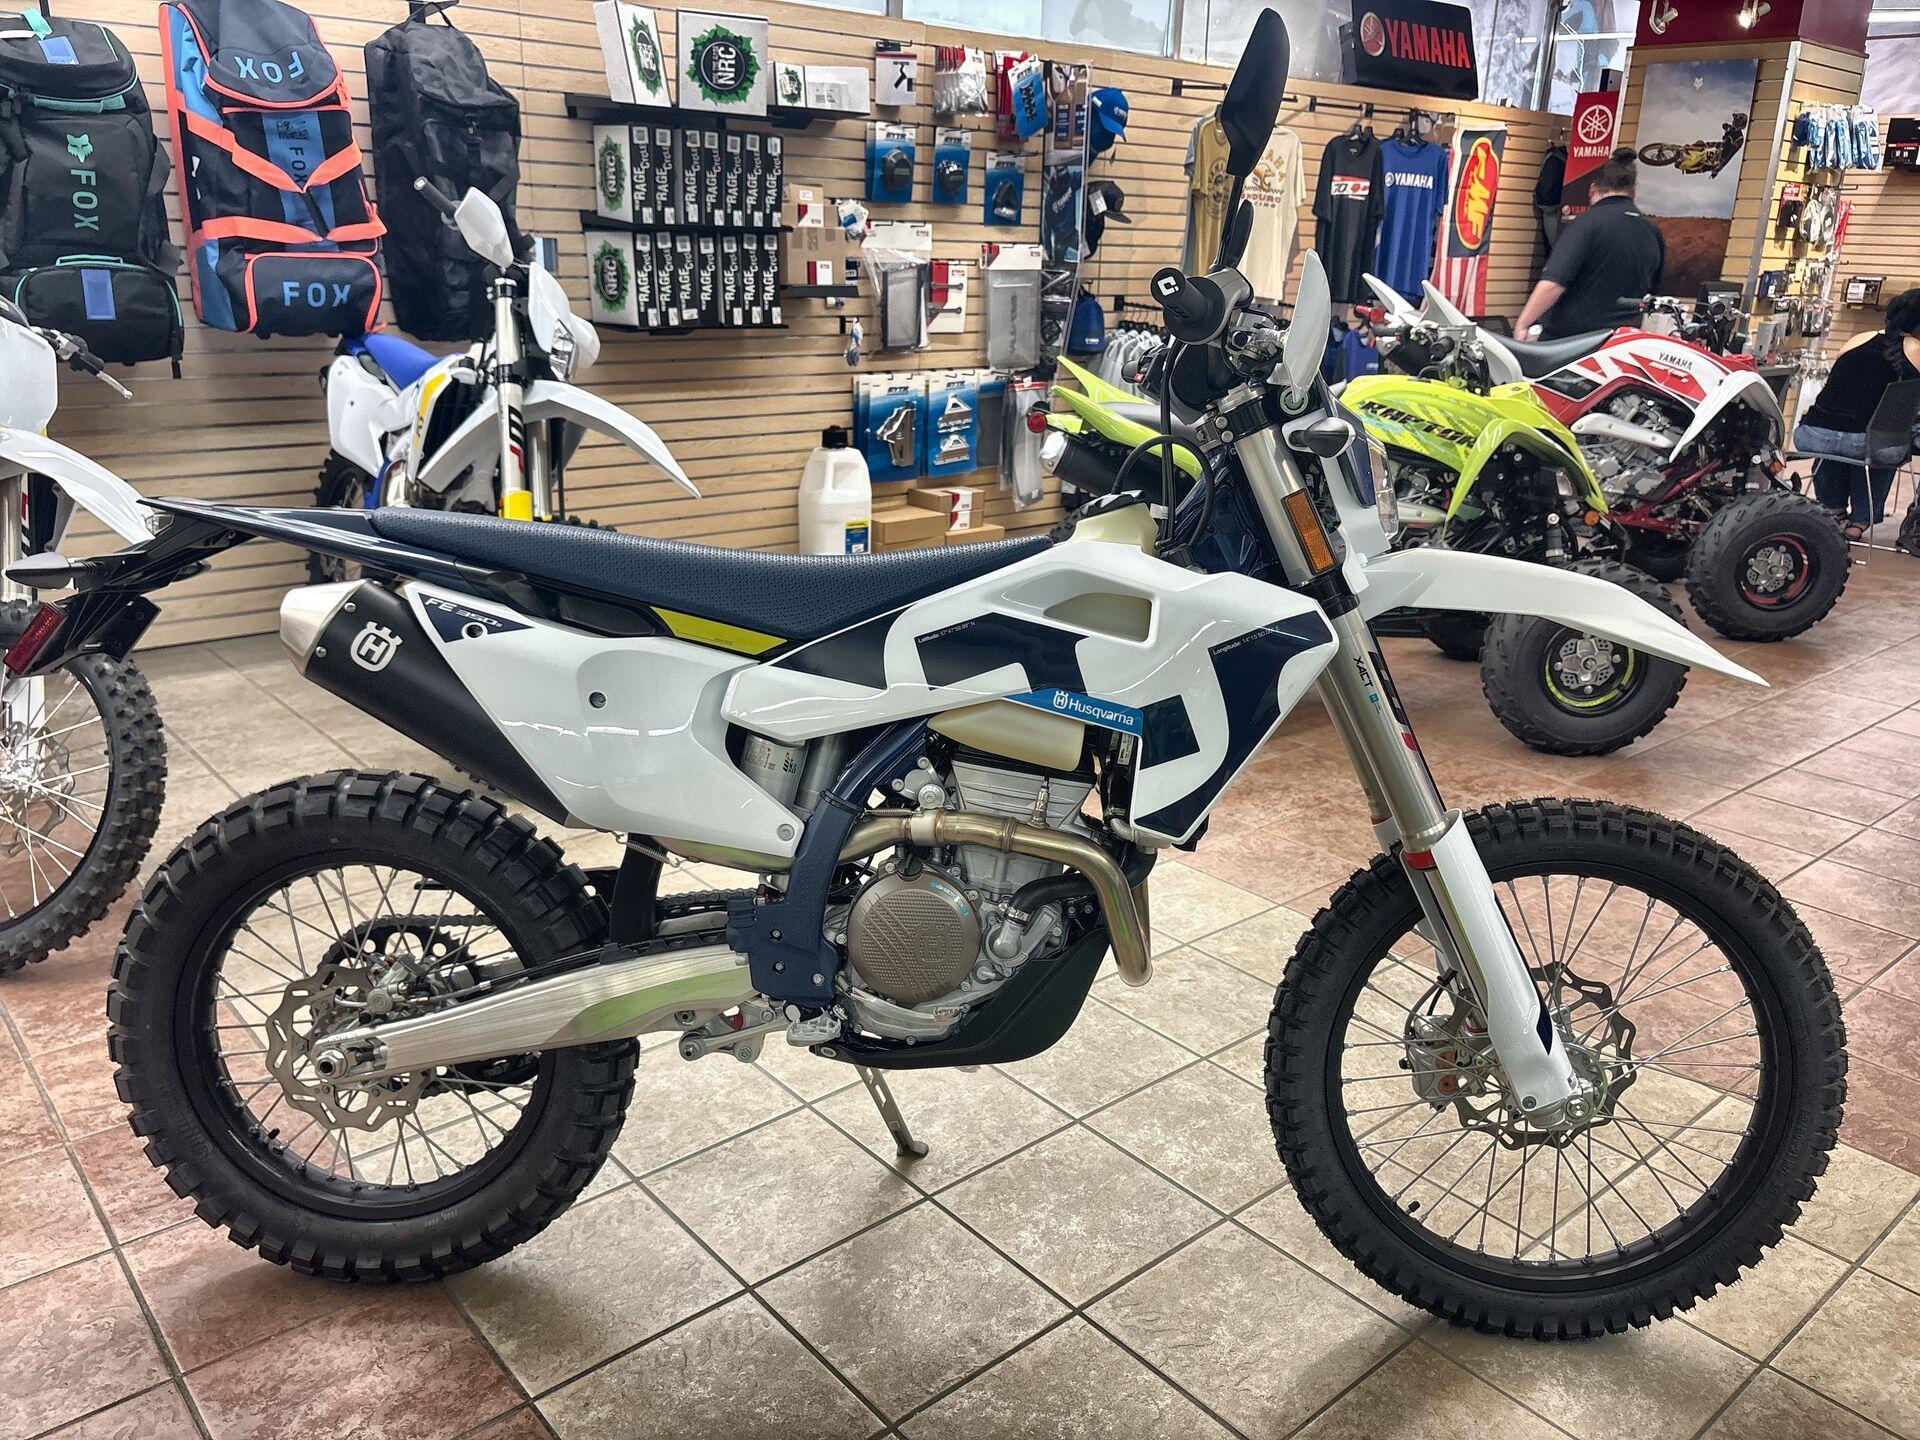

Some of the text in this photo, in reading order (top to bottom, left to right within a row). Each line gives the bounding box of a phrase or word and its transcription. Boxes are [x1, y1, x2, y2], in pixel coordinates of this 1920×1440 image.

[1385, 18, 1470, 68] YAMAHA
[234, 51, 305, 83] FOX
[717, 47, 737, 85] NRC
[289, 147, 309, 183] FOX
[1573, 146, 1610, 157] YAMAHA
[634, 167, 647, 200] RAGE
[656, 168, 669, 200] RAGE
[685, 170, 697, 202] RAGE
[706, 170, 717, 203] RAGE
[726, 172, 738, 204] RAGE
[746, 173, 758, 204] RAGE
[765, 173, 777, 204] RAGE
[1395, 172, 1433, 190] YAMAHA
[70, 168, 99, 231] FOX
[282, 281, 351, 307] FOX
[638, 270, 650, 302] RAGE
[659, 270, 671, 301] RAGE
[678, 268, 691, 299] RAGE
[700, 269, 712, 300] RAGE
[724, 270, 735, 300] RAGE
[744, 270, 755, 300] RAGE
[763, 271, 775, 300] RAGE
[1659, 352, 1692, 370] YAMAHA
[1360, 401, 1478, 448] RAPTOR
[425, 598, 457, 612] FE
[1353, 655, 1374, 687] XACT
[1069, 698, 1134, 726] Husqvarna
